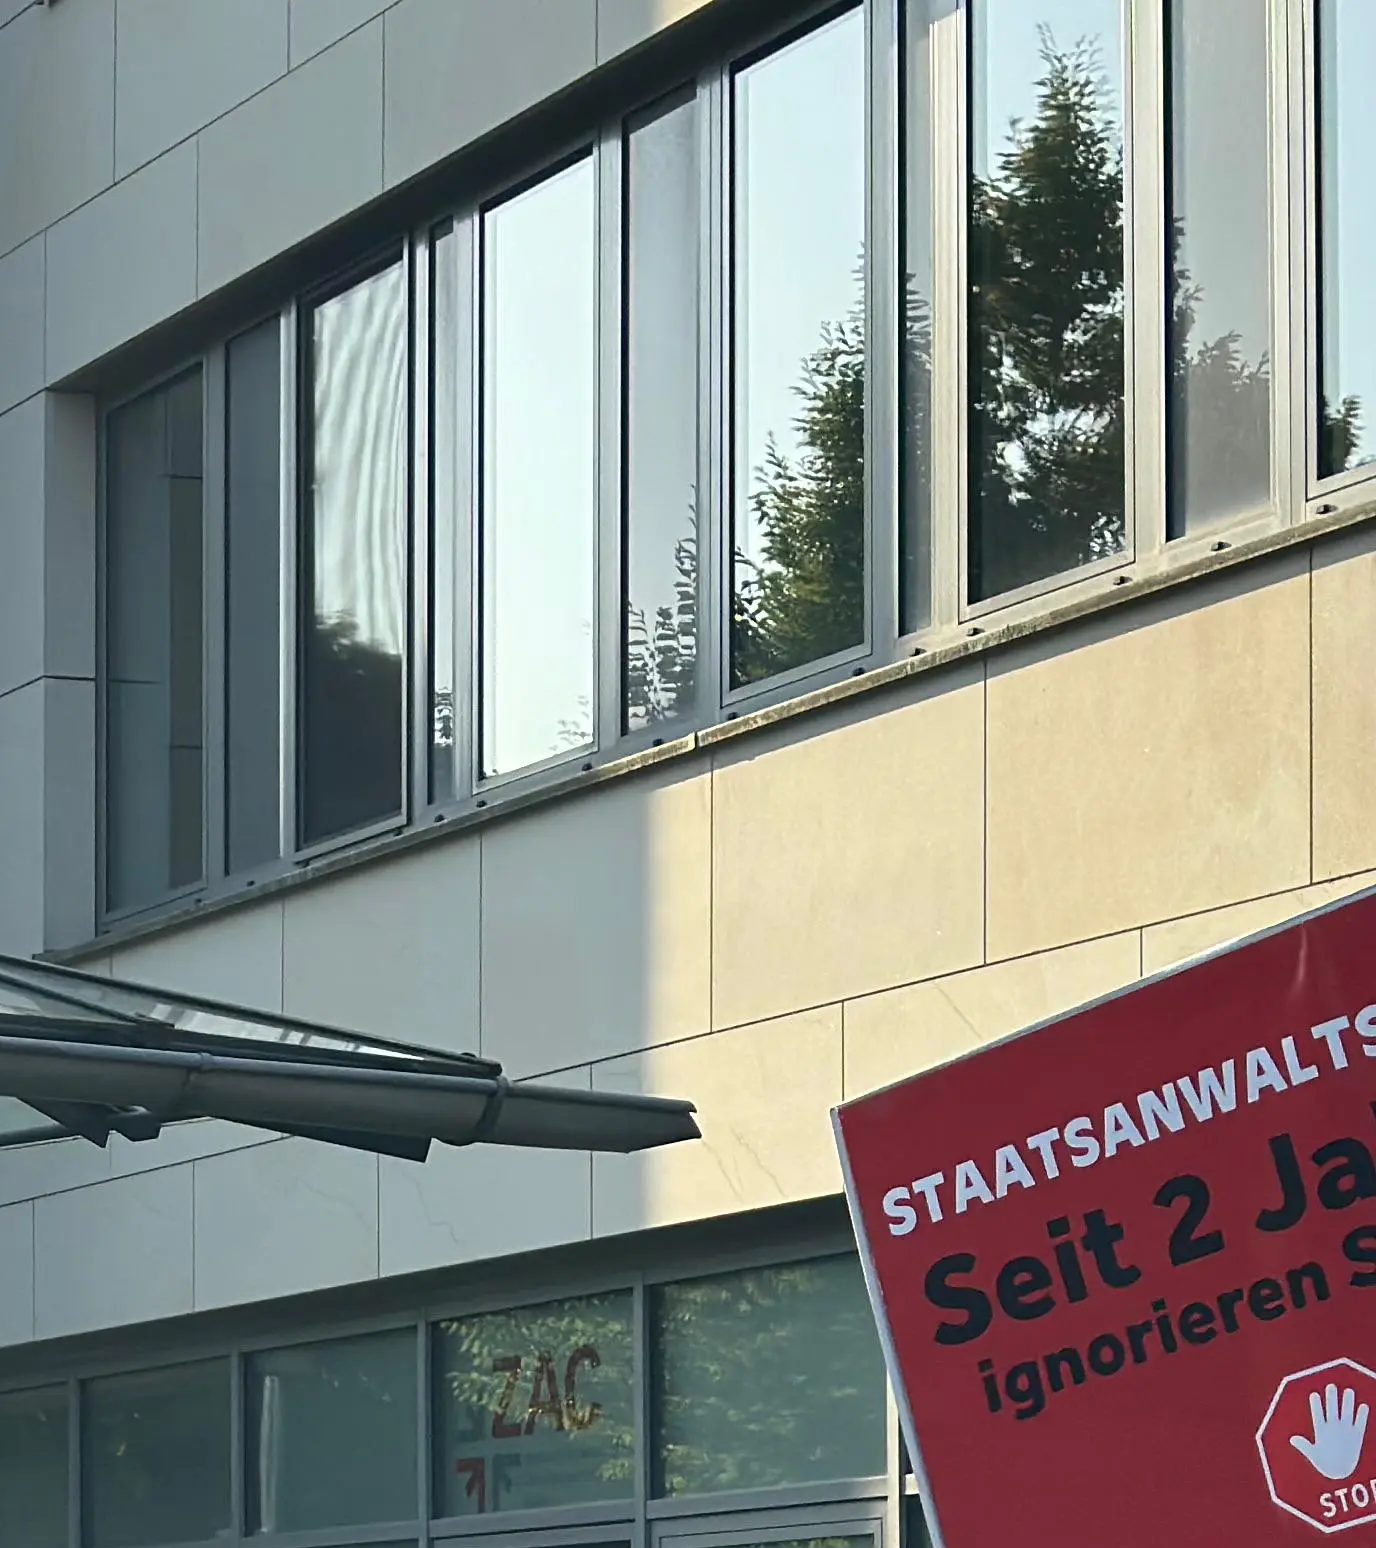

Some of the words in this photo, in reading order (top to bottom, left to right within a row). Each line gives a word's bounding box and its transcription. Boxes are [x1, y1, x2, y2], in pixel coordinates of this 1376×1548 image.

[923, 1208, 1141, 1346] Seit
[1154, 1174, 1226, 1266] 2
[1255, 1100, 1376, 1232] Ja
[492, 1345, 602, 1438] ZAC
[978, 1259, 1329, 1420] ignorieren
